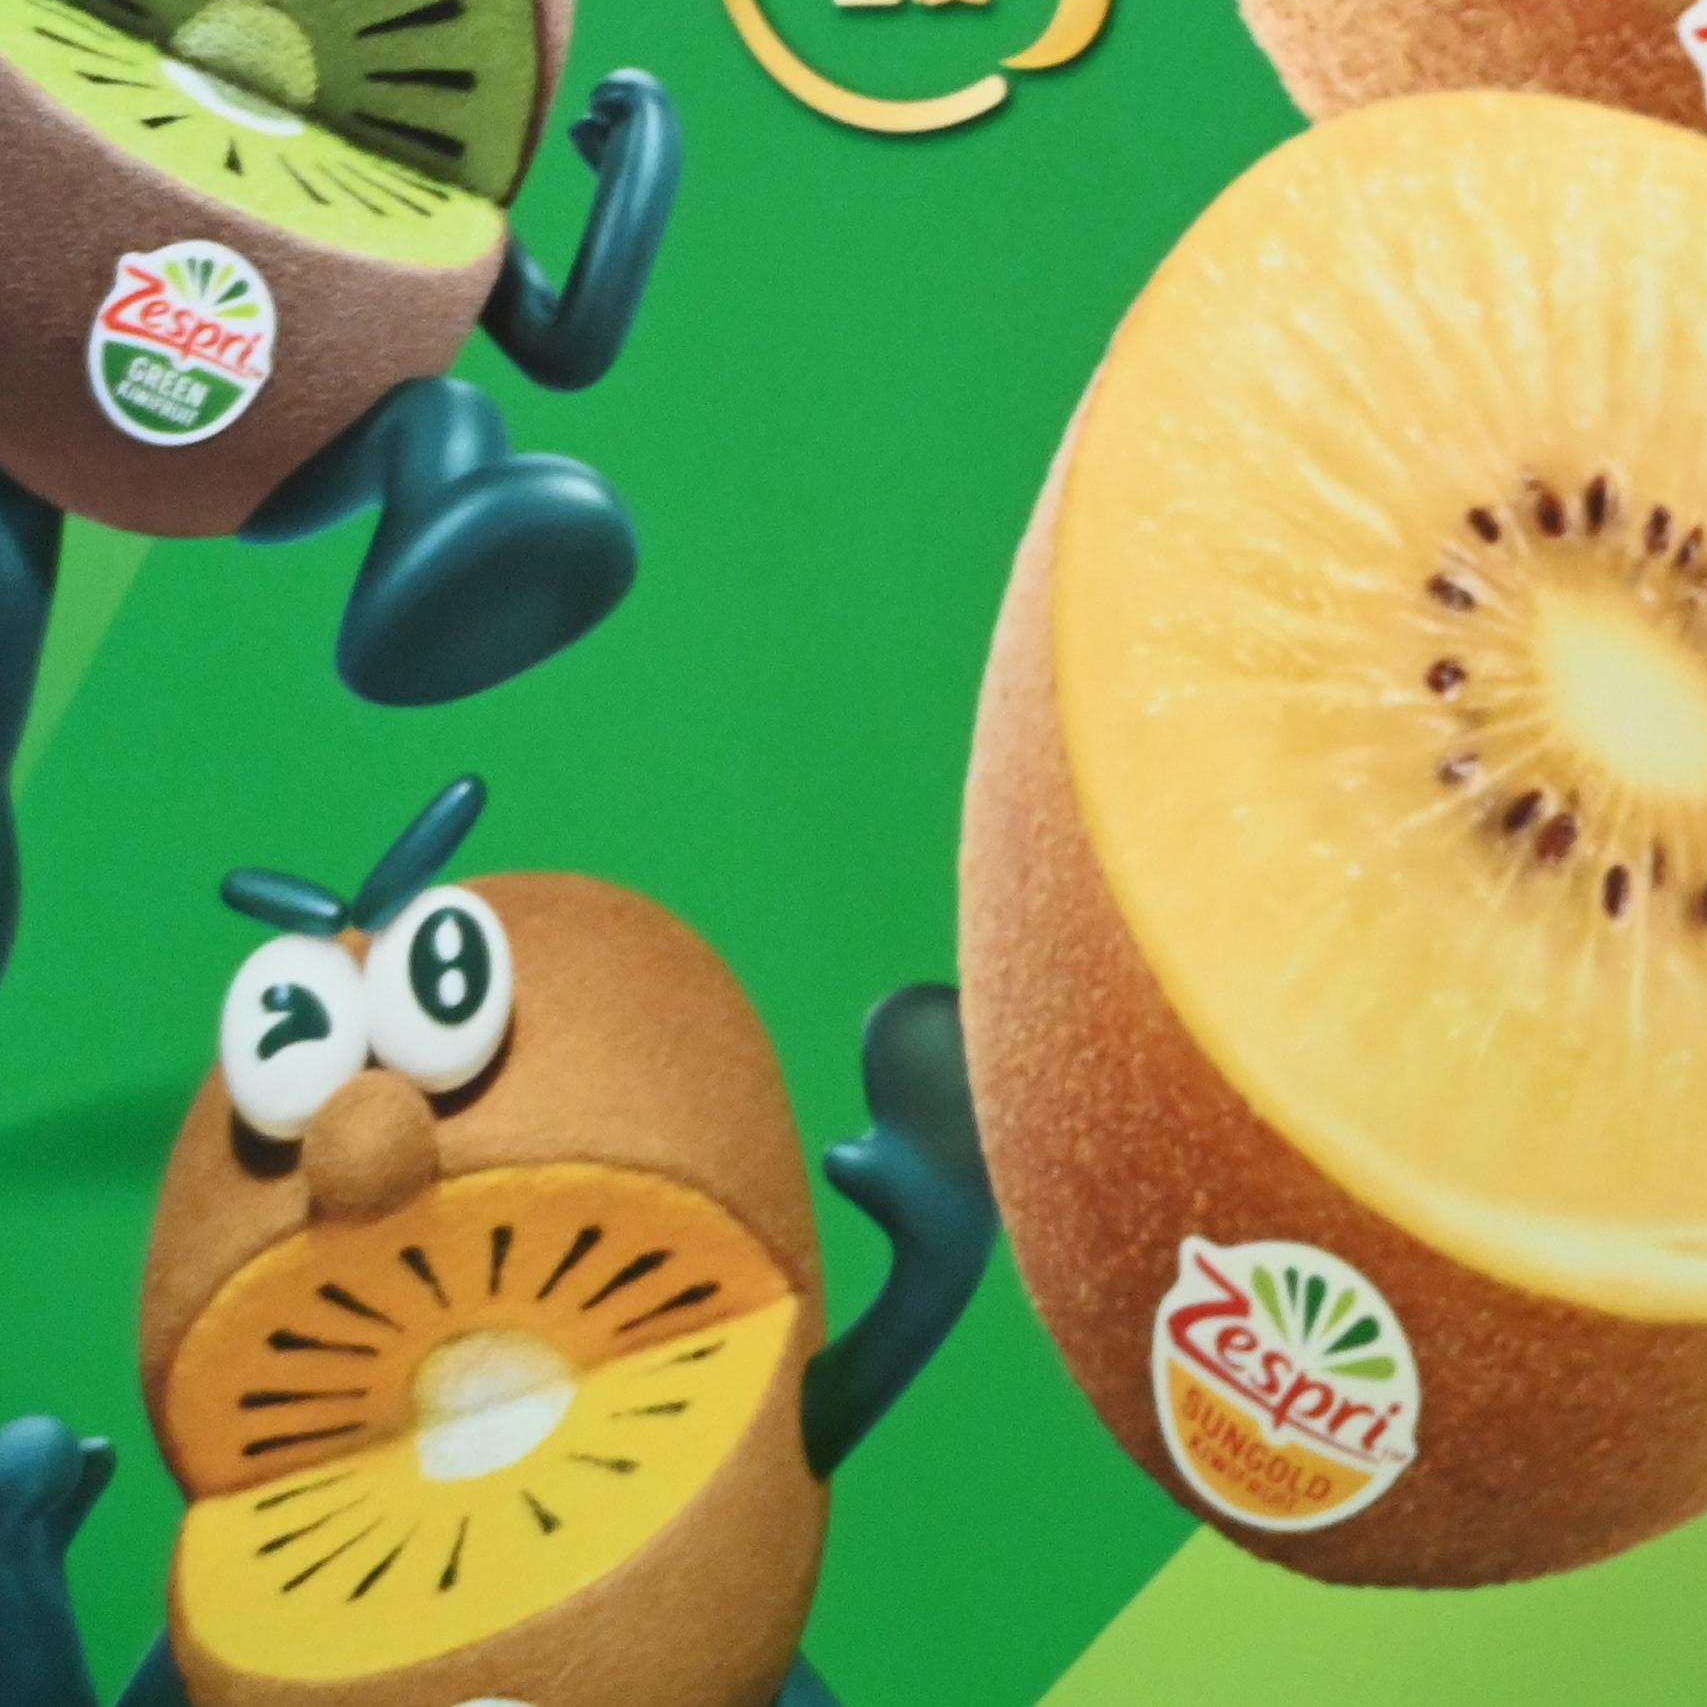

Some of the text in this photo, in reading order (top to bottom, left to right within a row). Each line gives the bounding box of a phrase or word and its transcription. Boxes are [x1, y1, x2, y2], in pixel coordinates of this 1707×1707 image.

[102, 264, 263, 378] Zespri
[1168, 1252, 1401, 1462] Zespri
[1181, 1387, 1332, 1501] SUNGOLD
